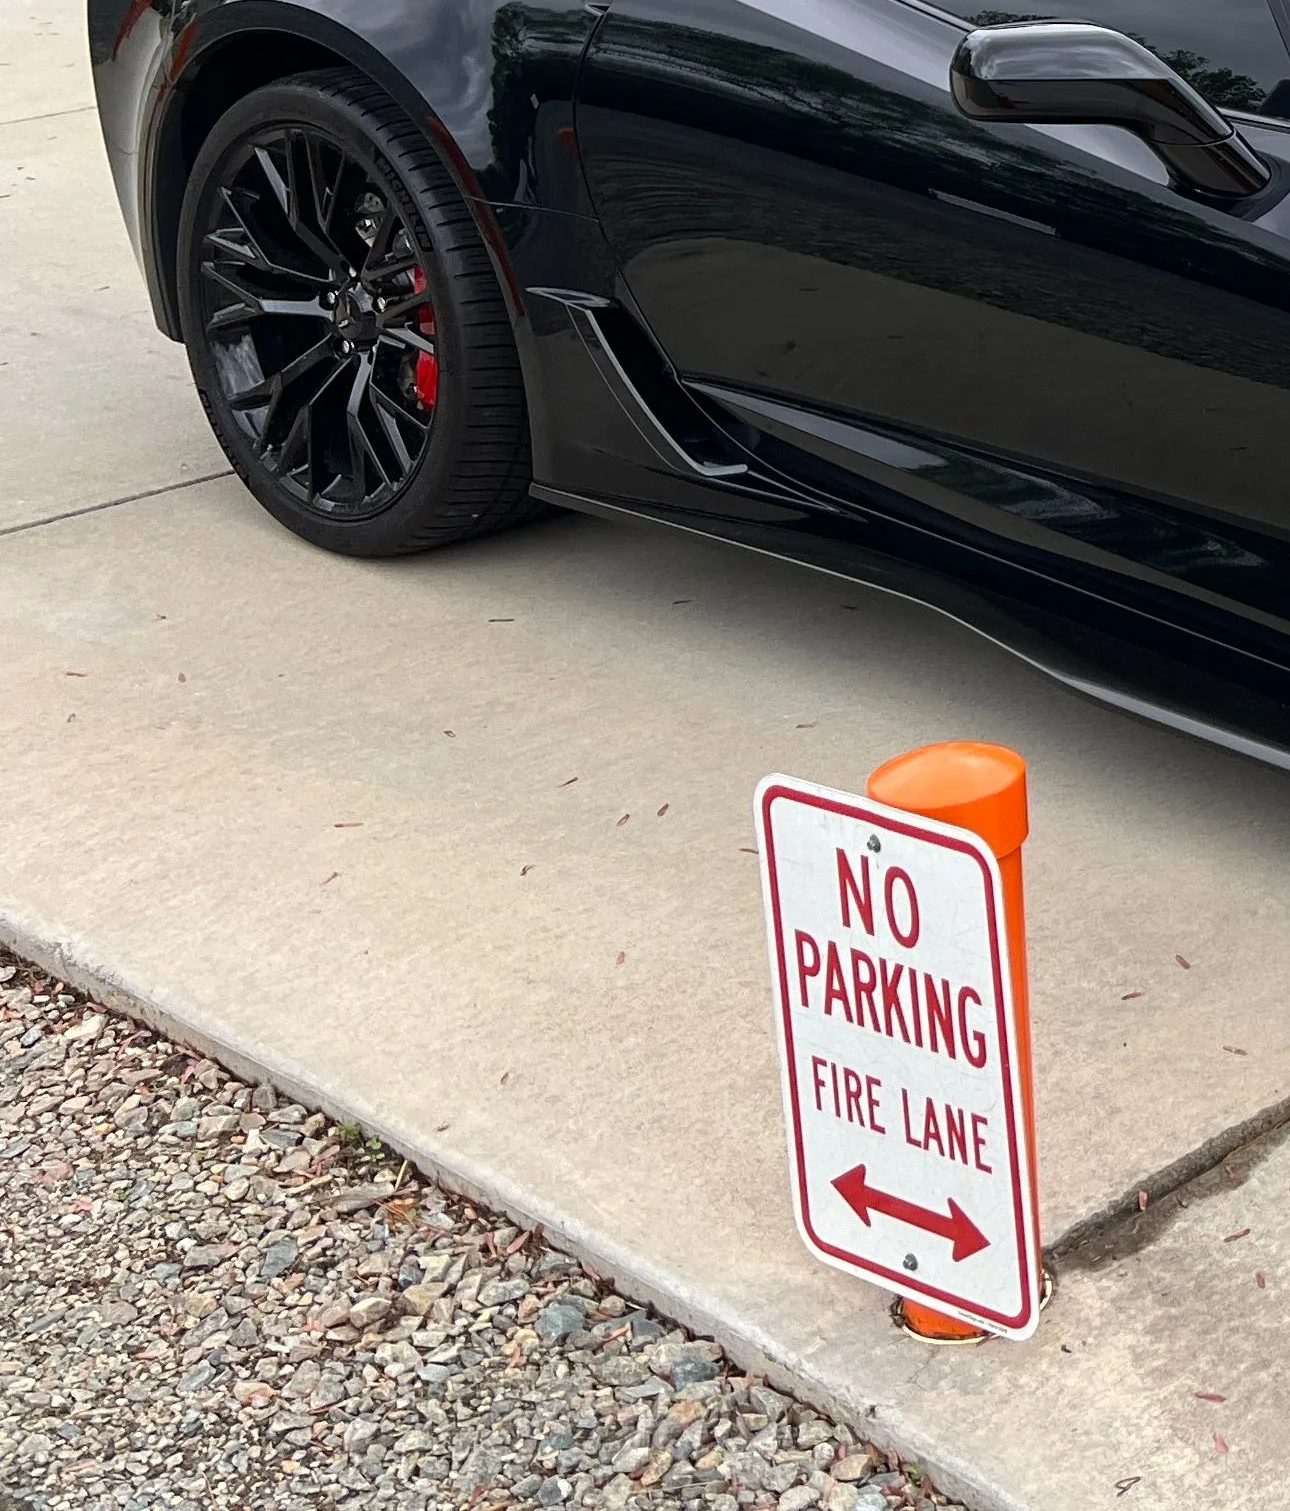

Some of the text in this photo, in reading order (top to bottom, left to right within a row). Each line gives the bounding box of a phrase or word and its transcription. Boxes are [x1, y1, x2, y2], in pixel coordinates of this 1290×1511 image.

[836, 847, 920, 949] NO
[794, 928, 987, 1069] PARKING
[811, 1055, 993, 1174] FIRE LANE
